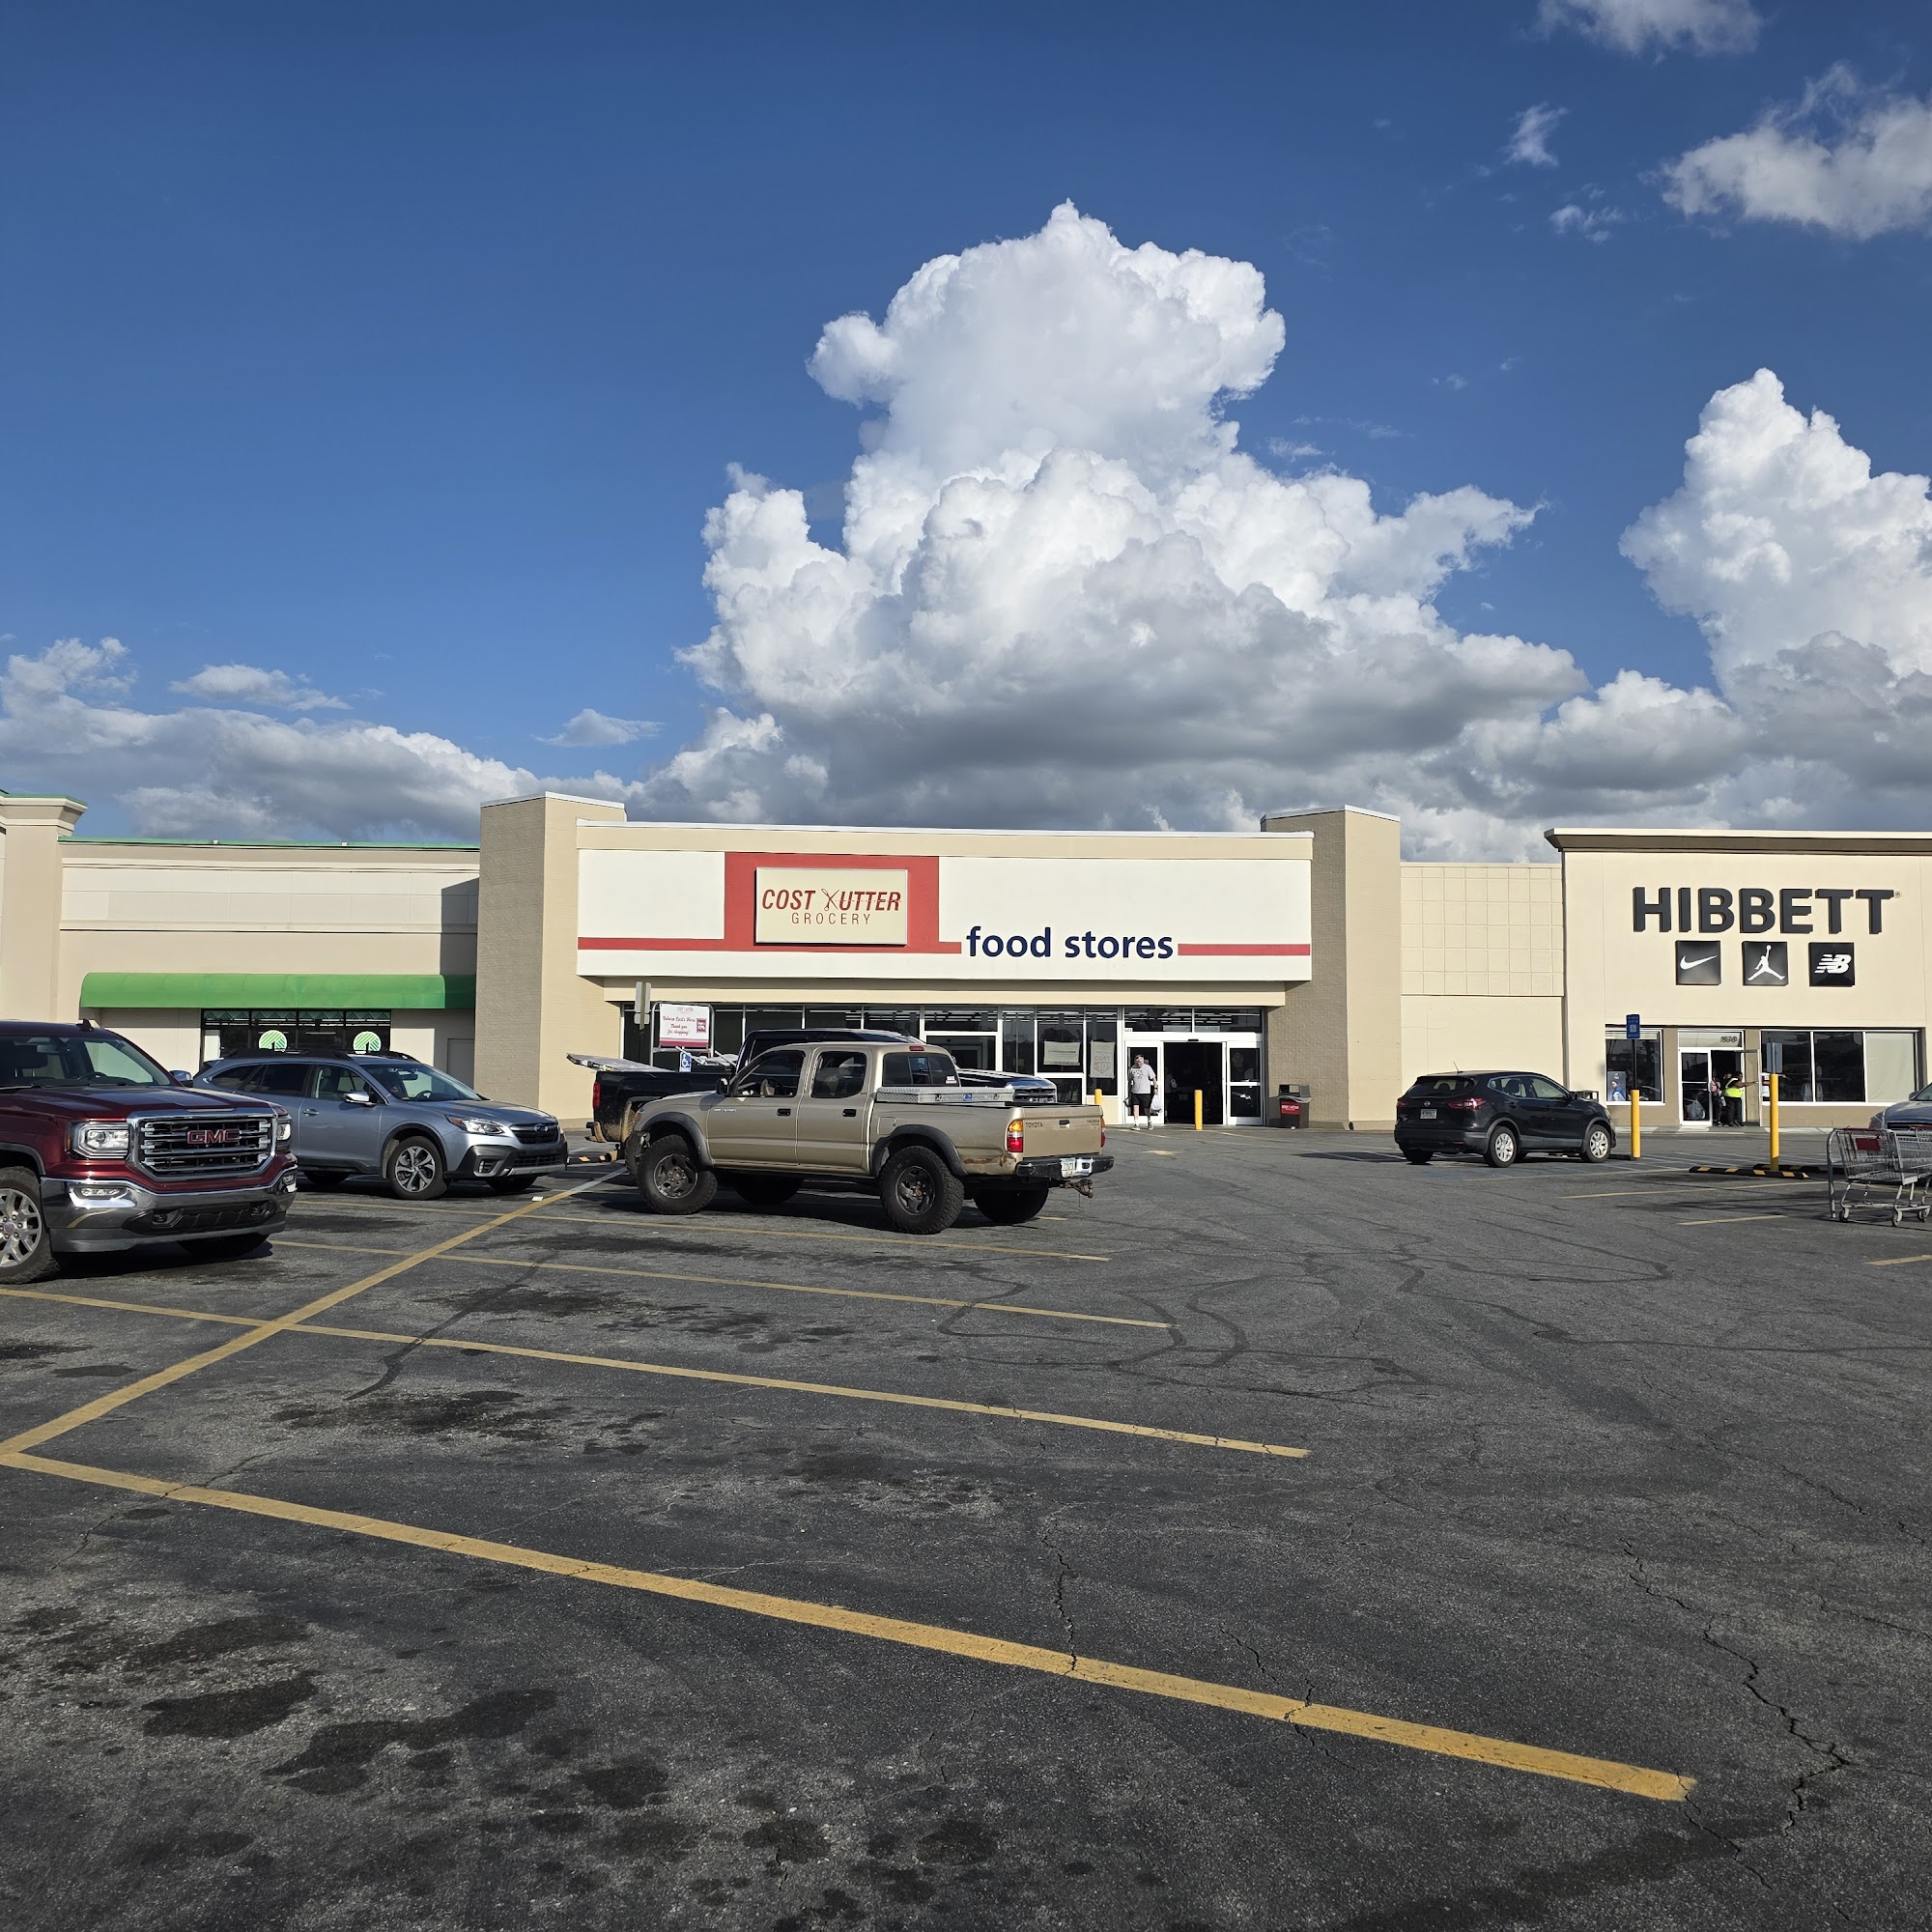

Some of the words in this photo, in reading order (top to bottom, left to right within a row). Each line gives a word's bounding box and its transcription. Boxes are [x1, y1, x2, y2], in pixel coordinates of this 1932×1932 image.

[762, 889, 817, 910] COST
[791, 912, 870, 925] GROCERY
[1633, 887, 1895, 934] HIBBETT
[966, 925, 1051, 957] food
[1065, 930, 1174, 959] stores
[187, 1128, 242, 1145] GMC
